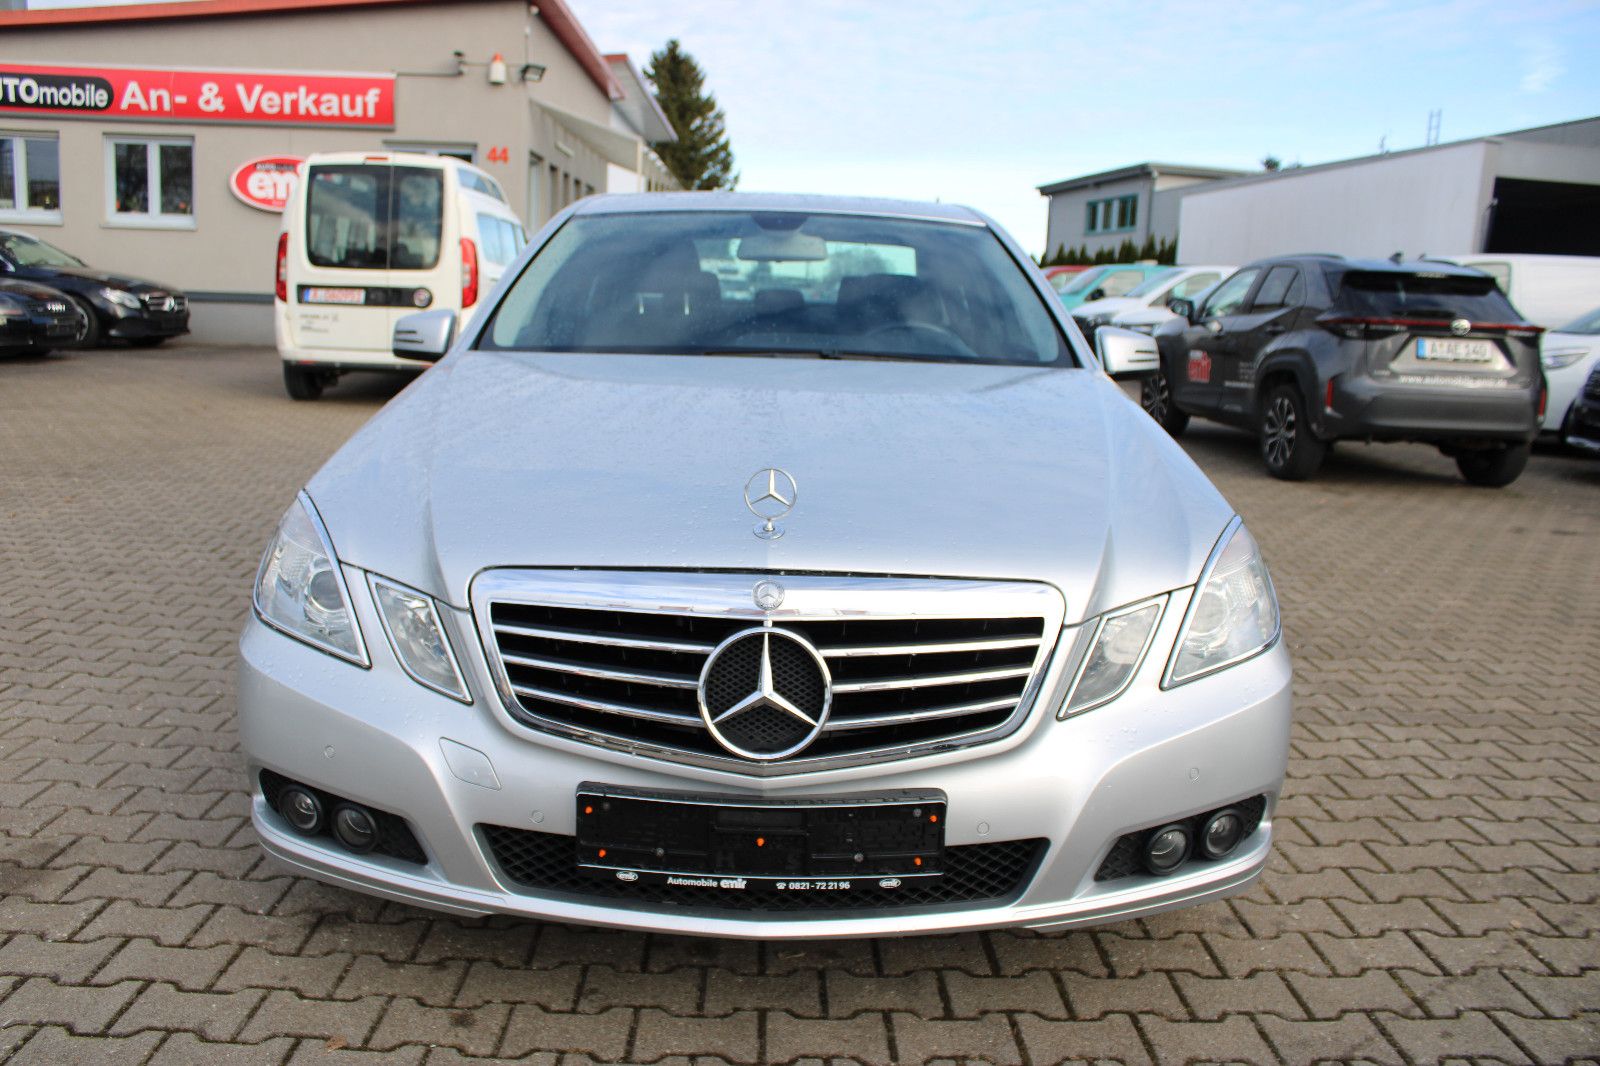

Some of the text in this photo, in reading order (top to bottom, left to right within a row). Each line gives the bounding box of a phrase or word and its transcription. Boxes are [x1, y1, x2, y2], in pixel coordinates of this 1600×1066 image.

[0, 77, 381, 118] TOmobile An- & Verkauf
[486, 146, 509, 165] 44
[667, 876, 747, 889] Automobile emir
